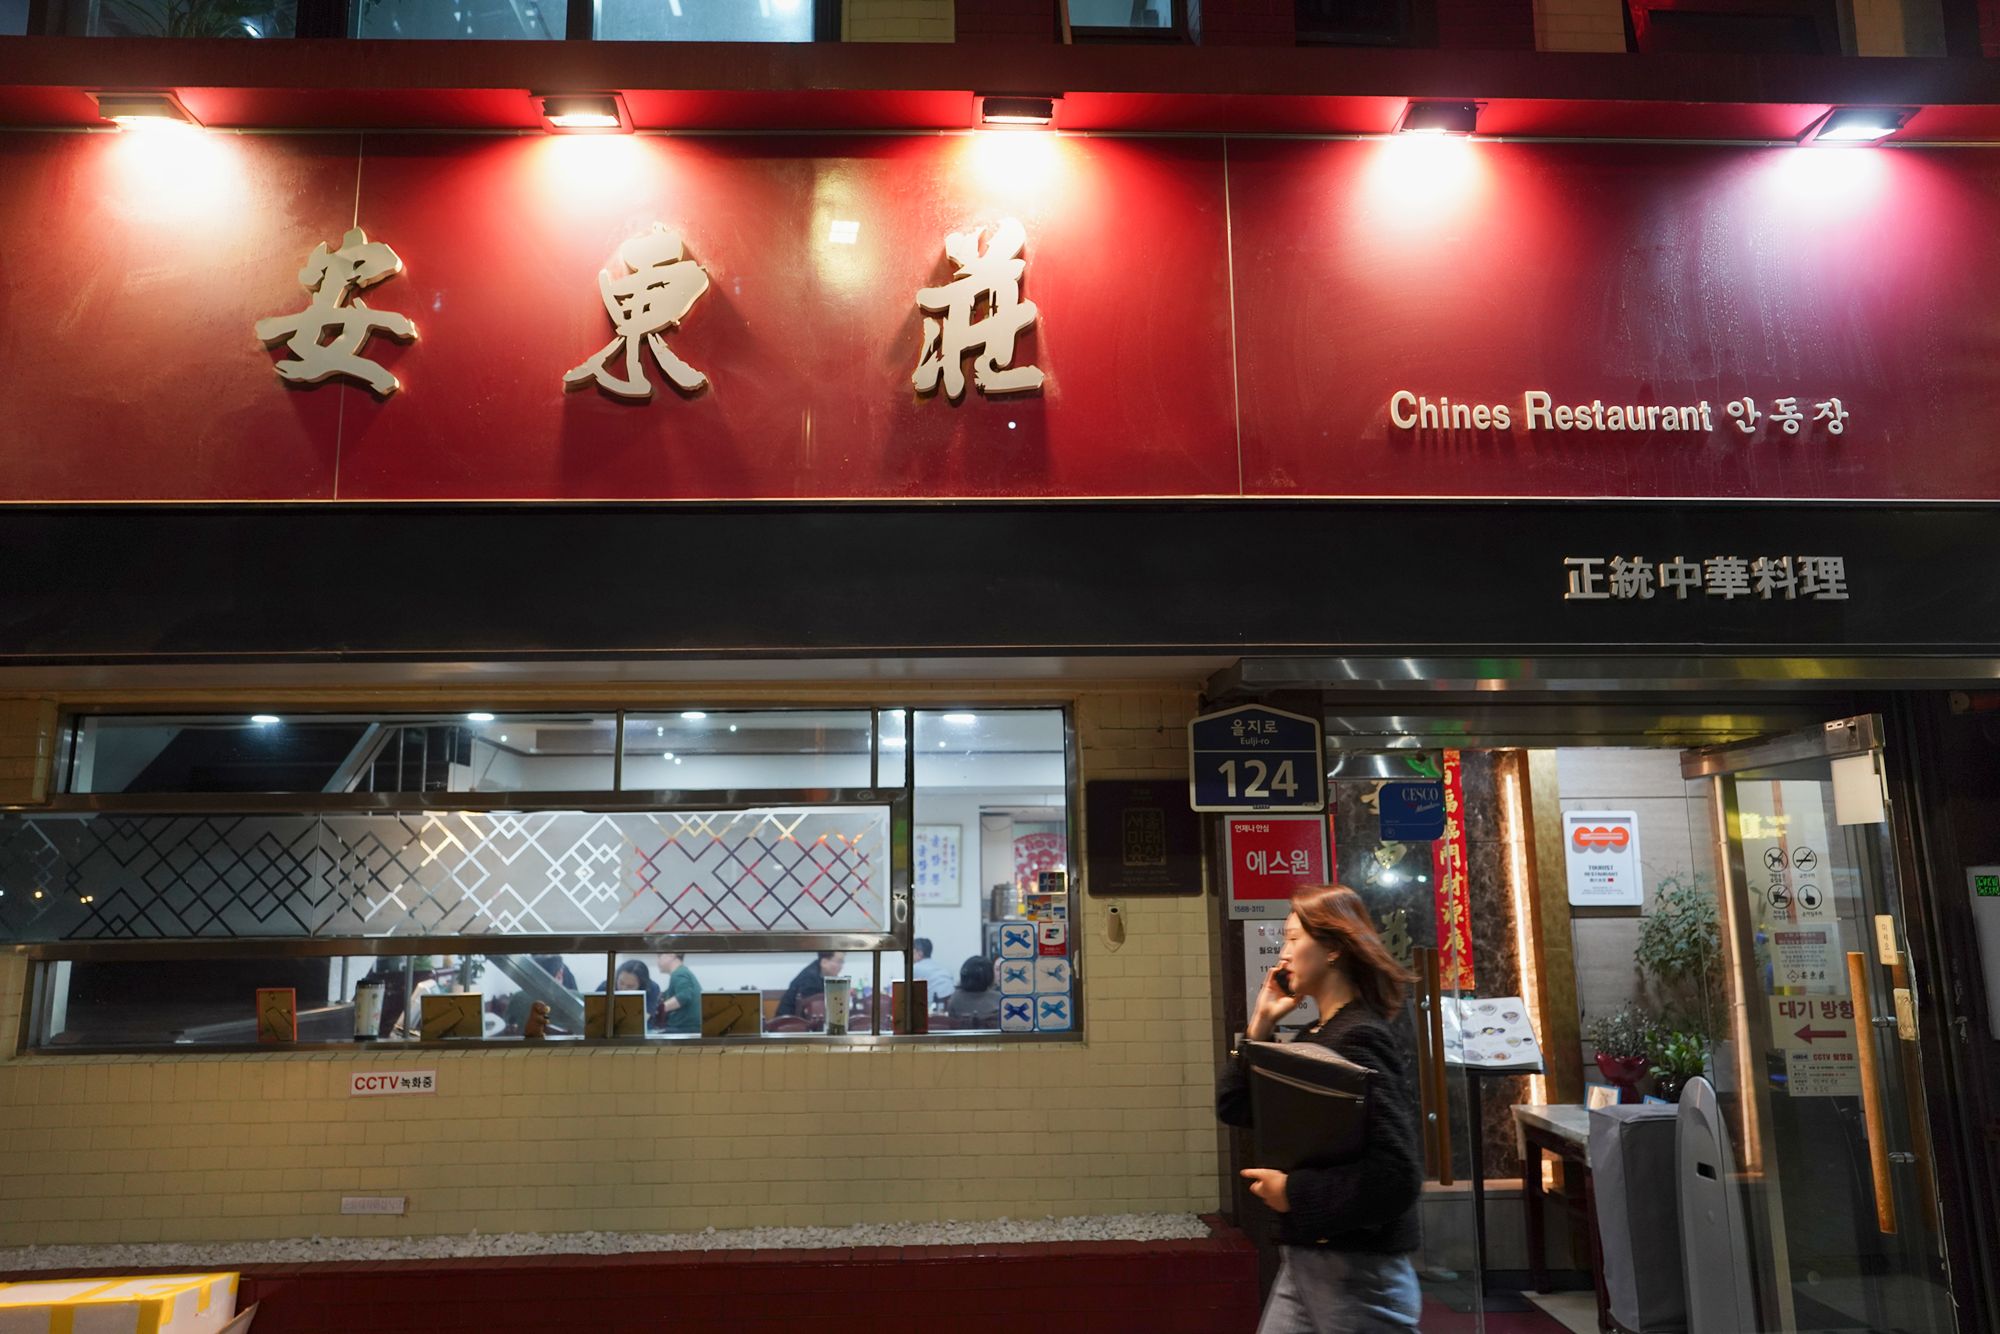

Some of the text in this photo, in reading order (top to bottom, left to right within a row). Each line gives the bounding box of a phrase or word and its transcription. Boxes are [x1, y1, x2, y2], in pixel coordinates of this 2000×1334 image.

[255, 218, 1045, 400] 安東莊
[1390, 390, 1850, 435] Chines Restaurant 안동장
[1563, 555, 1849, 600] 正統中華料理
[1230, 719, 1279, 736] 을지로
[1240, 737, 1270, 747] Eulji-ro
[1217, 759, 1299, 798] 124
[1401, 787, 1439, 801] CESCO
[1234, 824, 1270, 833] 언제나 안심
[1245, 849, 1310, 876] 에스원
[1779, 1000, 1855, 1020] 대기 방향
[1813, 1053, 1831, 1061] CCTV
[354, 1075, 433, 1091] CCTV 녹화중
